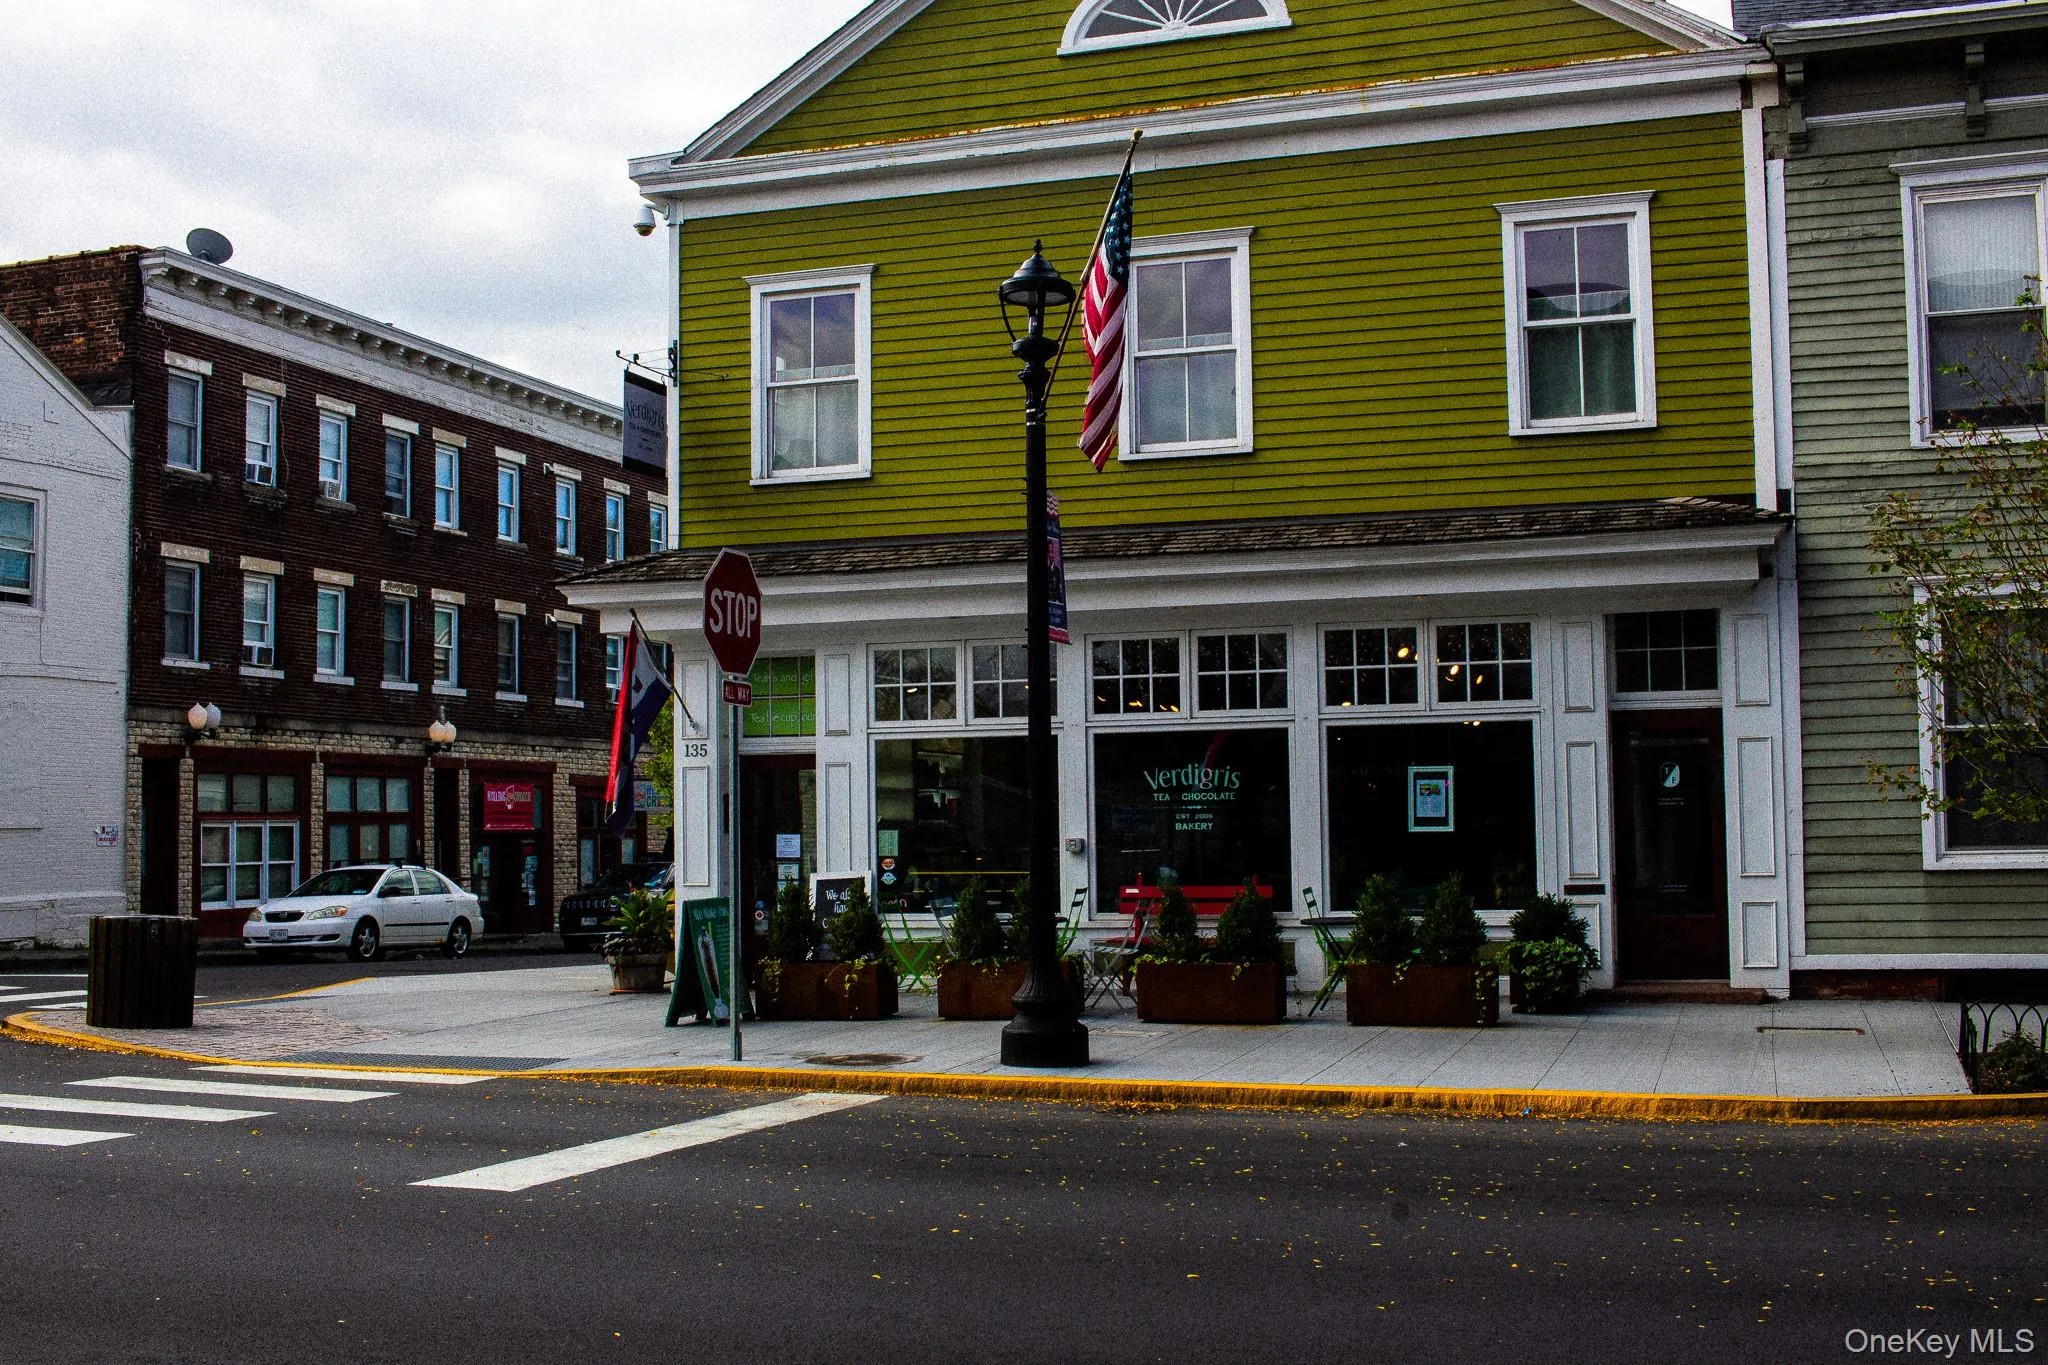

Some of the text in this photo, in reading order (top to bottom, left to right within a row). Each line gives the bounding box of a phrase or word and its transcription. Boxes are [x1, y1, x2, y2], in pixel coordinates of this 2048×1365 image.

[709, 588, 758, 638] STOP
[725, 685, 750, 702] ALL WAY
[685, 743, 708, 758] 135
[1143, 763, 1241, 790] Verdigris
[1152, 792, 1236, 801] TEA CHOCOLATE
[1175, 822, 1214, 831] BAKERY
[825, 889, 839, 900] We
